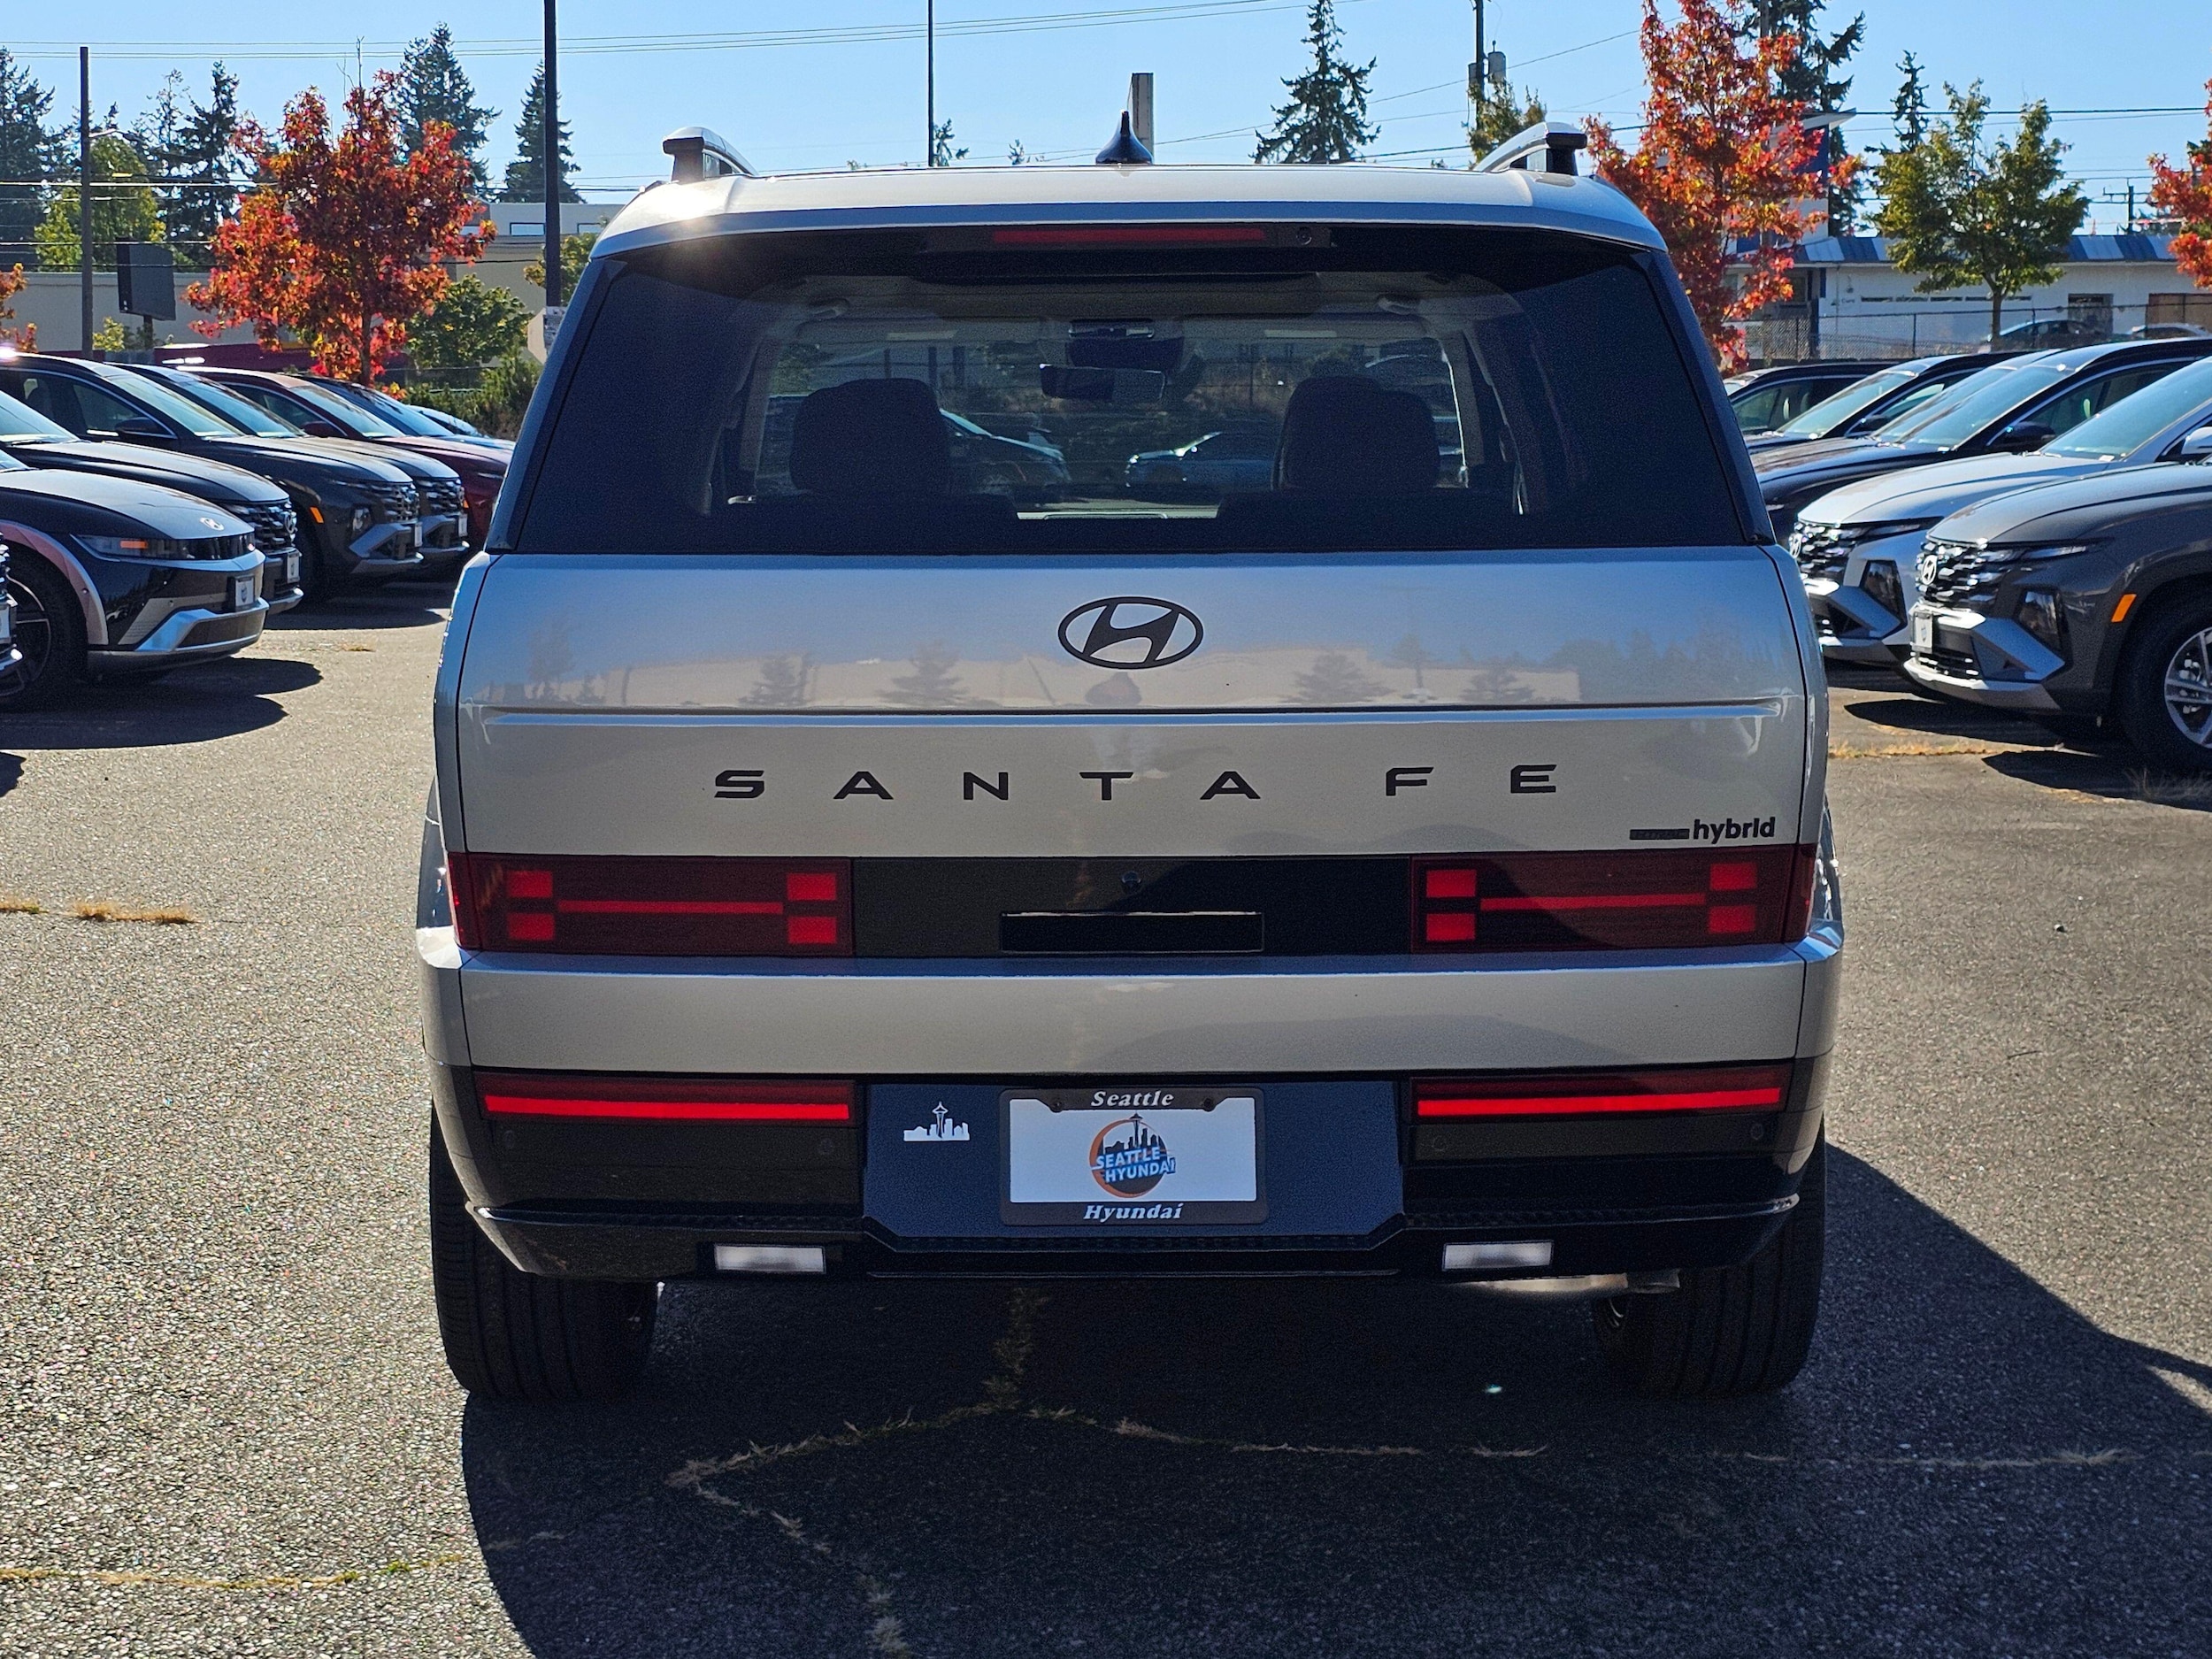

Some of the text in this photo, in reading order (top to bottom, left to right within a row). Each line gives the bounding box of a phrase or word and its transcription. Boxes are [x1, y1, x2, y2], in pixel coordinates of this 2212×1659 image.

[714, 764, 1556, 801] SANTA FE
[1693, 816, 1776, 845] hybrid
[1090, 1090, 1174, 1107] Seattle
[1092, 1147, 1161, 1170] SEATTLE
[1104, 1158, 1176, 1183] HYUNDAI
[1083, 1202, 1184, 1223] Hyundai
